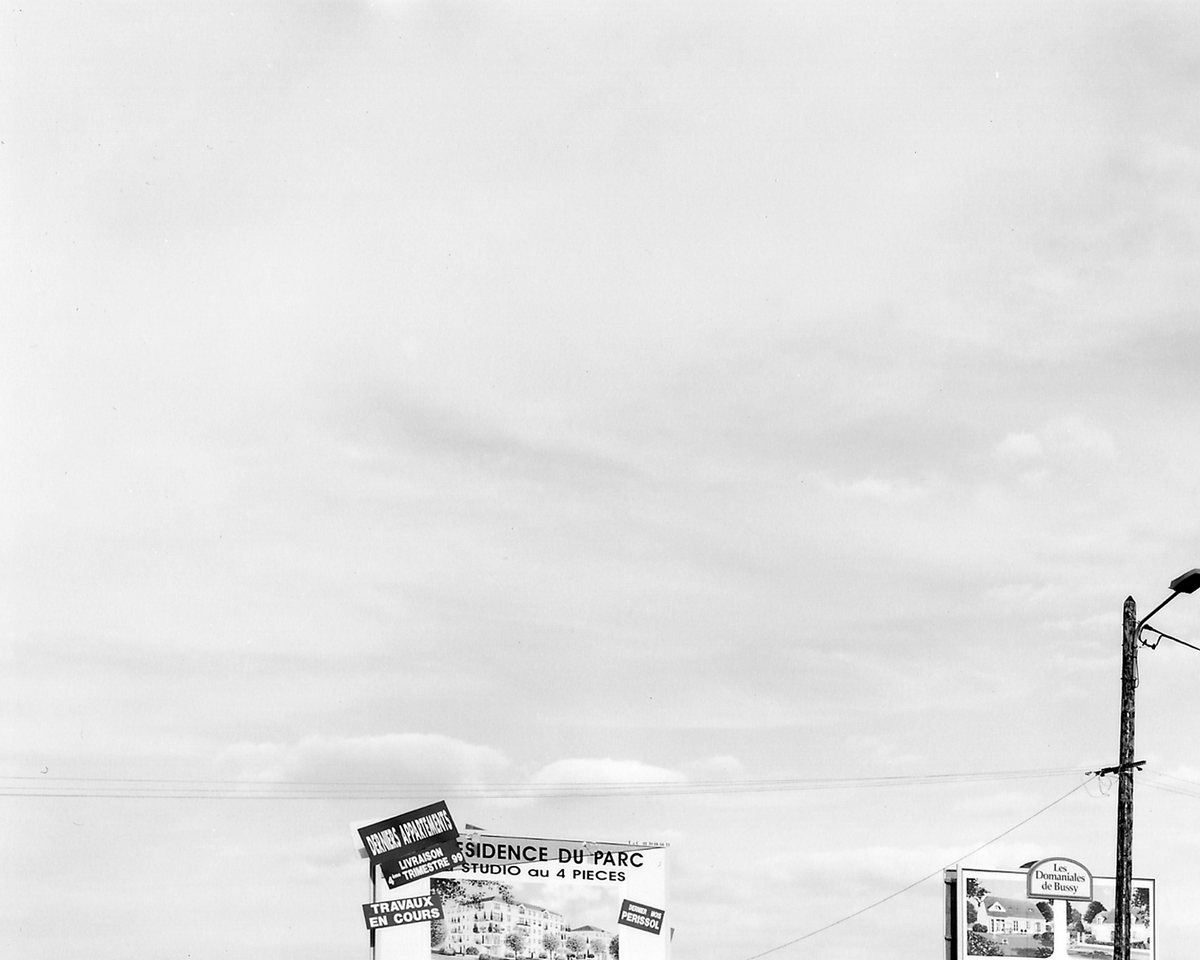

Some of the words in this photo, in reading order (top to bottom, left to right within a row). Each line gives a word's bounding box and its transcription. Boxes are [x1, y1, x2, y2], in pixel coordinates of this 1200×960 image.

[366, 827, 401, 856] DERNIERS
[399, 809, 453, 845] APPARTEMENTS
[398, 847, 444, 870] LIVRAISON
[402, 857, 450, 880] TRIMESTRE
[451, 852, 463, 864] 99
[559, 848, 584, 864] DU
[594, 850, 644, 868] PARC
[1054, 863, 1067, 872] Les
[461, 862, 521, 876] STUDIO
[528, 869, 549, 878] au
[556, 869, 565, 878] 4
[573, 870, 626, 881] PIECES
[1036, 870, 1085, 882] Domaniales
[1041, 881, 1052, 891] de
[1054, 882, 1078, 894] Bussy
[370, 896, 434, 914] TRAVAUX
[369, 915, 388, 928] EN
[393, 908, 440, 924] COURS
[621, 911, 660, 930] PERISSOL
